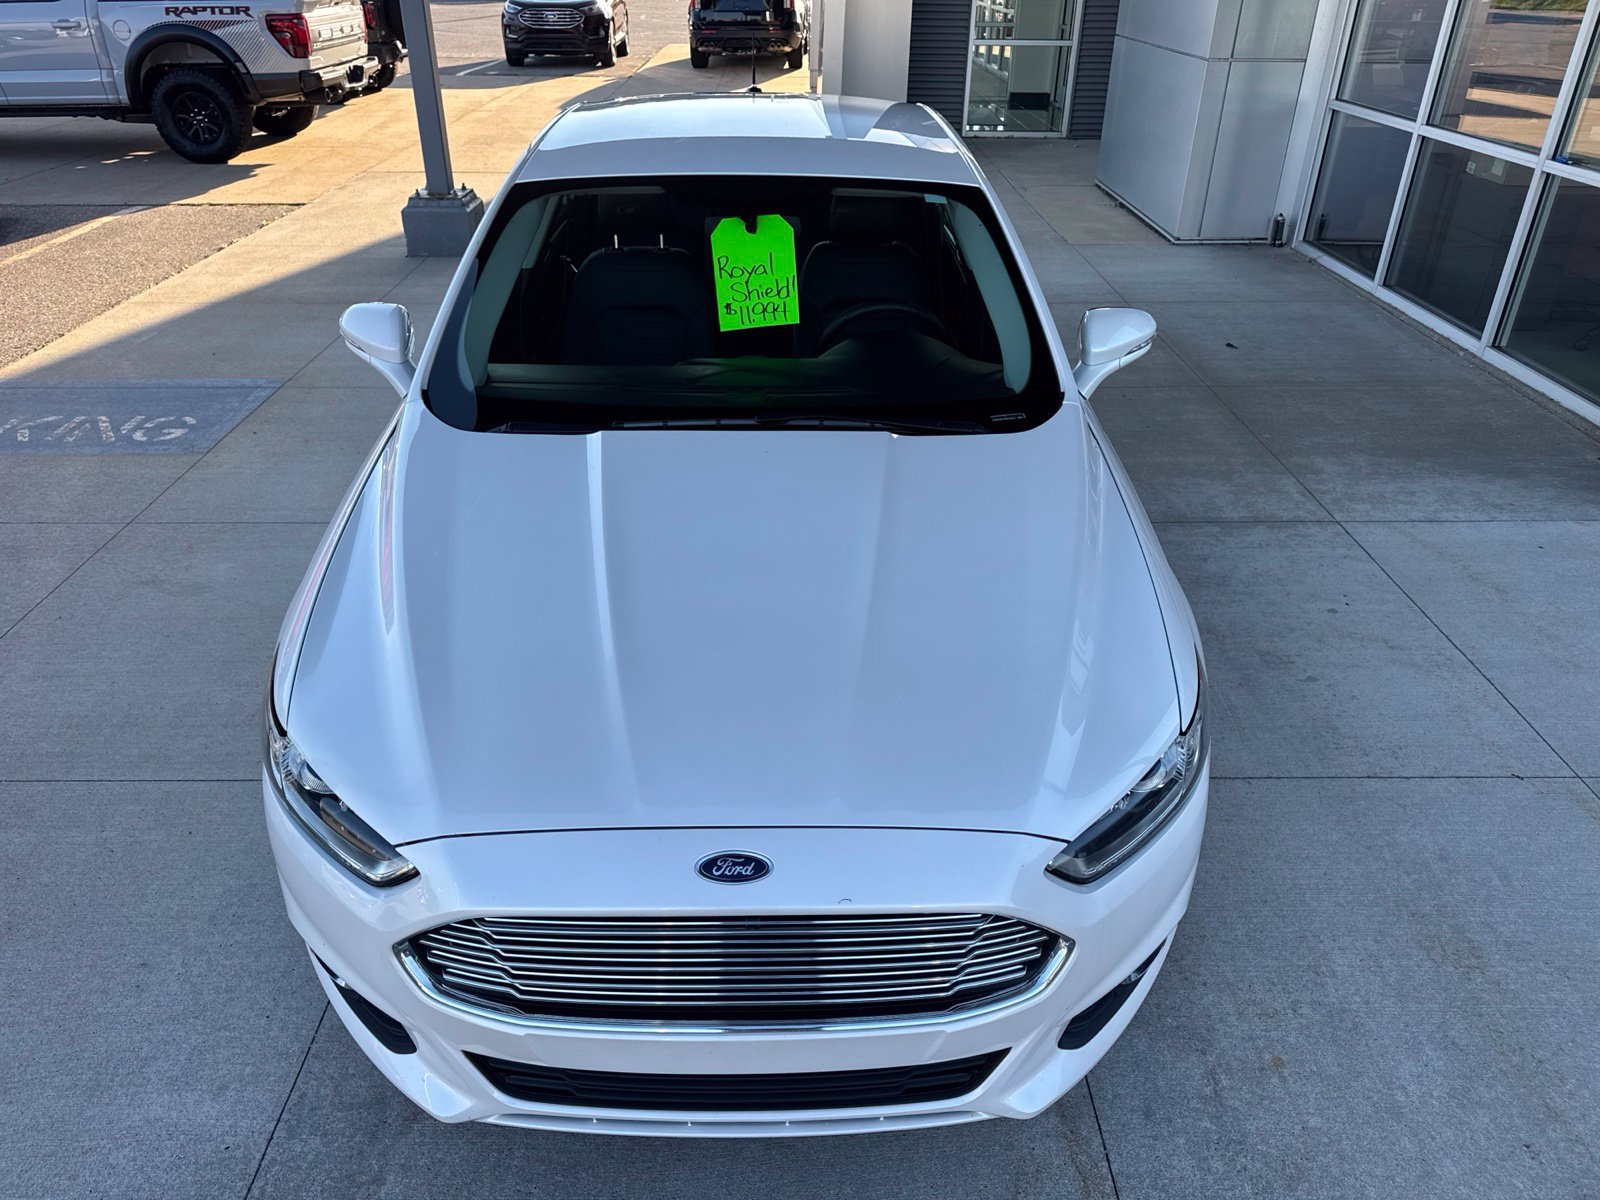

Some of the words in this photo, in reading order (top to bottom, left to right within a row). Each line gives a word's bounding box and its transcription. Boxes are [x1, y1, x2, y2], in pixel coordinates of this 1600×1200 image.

[164, 6, 255, 19] RAPTOR
[717, 251, 775, 284] Royal
[712, 857, 756, 876] Ford
